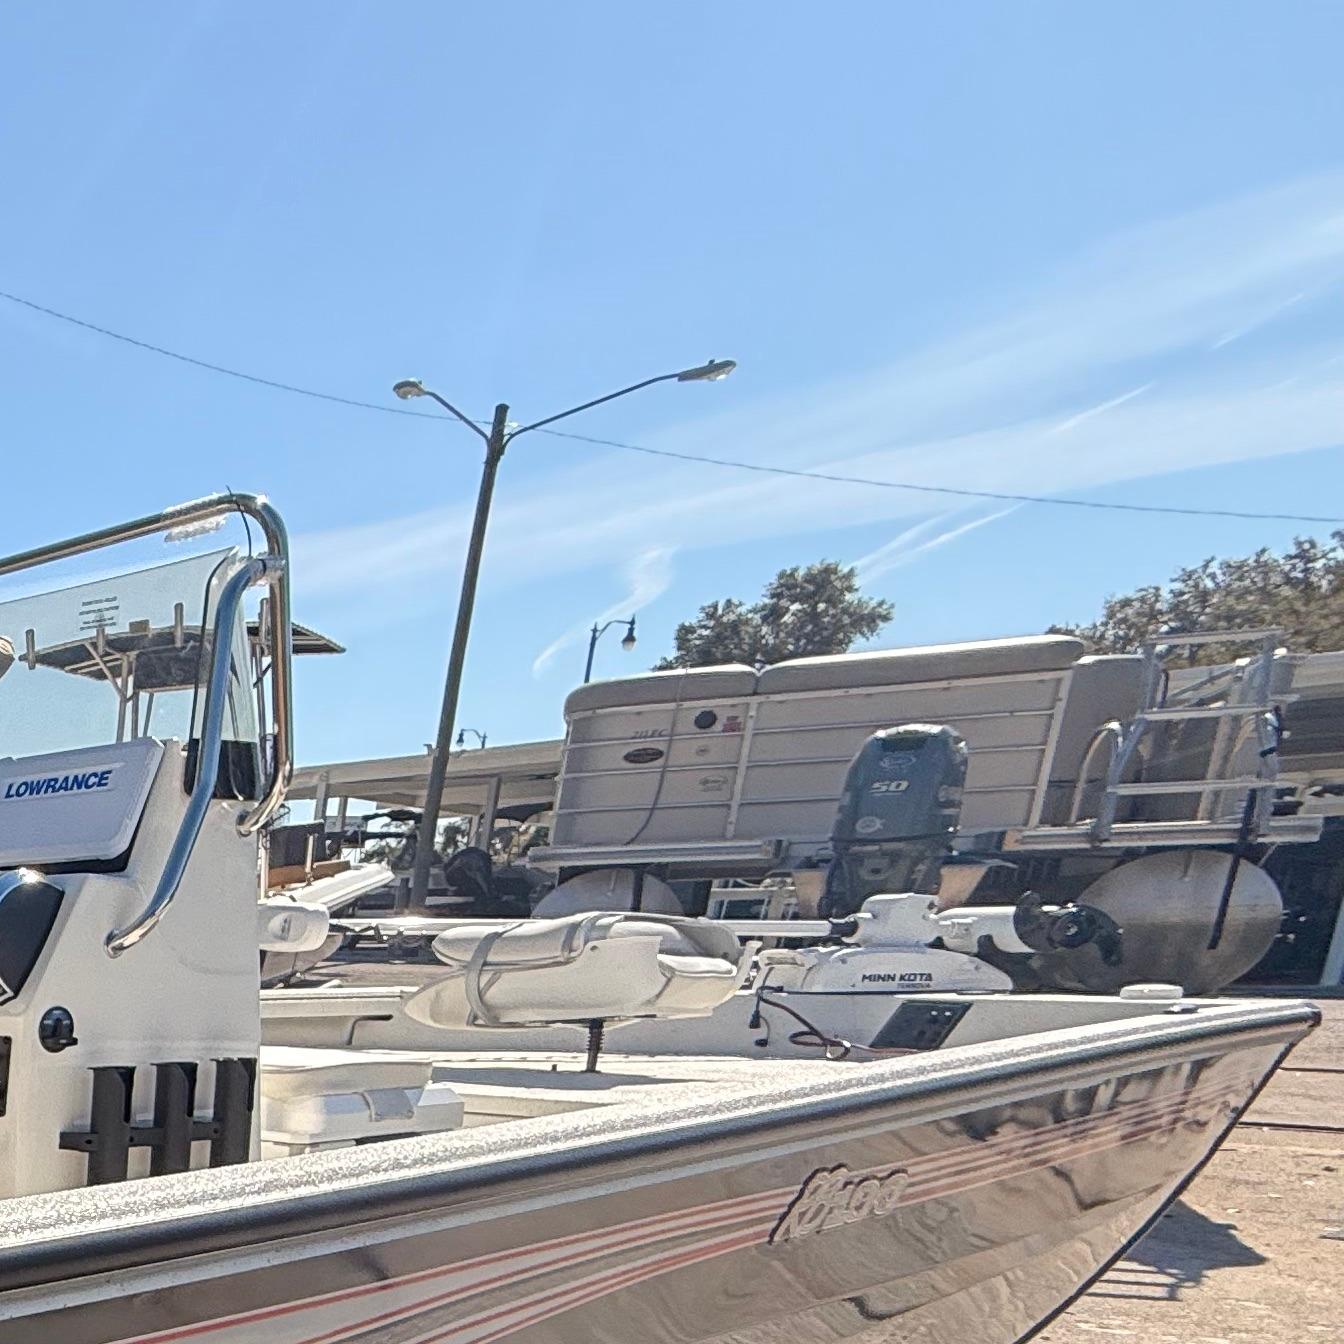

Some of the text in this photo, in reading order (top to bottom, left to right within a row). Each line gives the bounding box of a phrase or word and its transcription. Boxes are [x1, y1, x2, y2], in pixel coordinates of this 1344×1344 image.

[4, 769, 112, 799] LOWRANCE
[870, 779, 910, 793] 50
[862, 972, 933, 983] MINN KOTA
